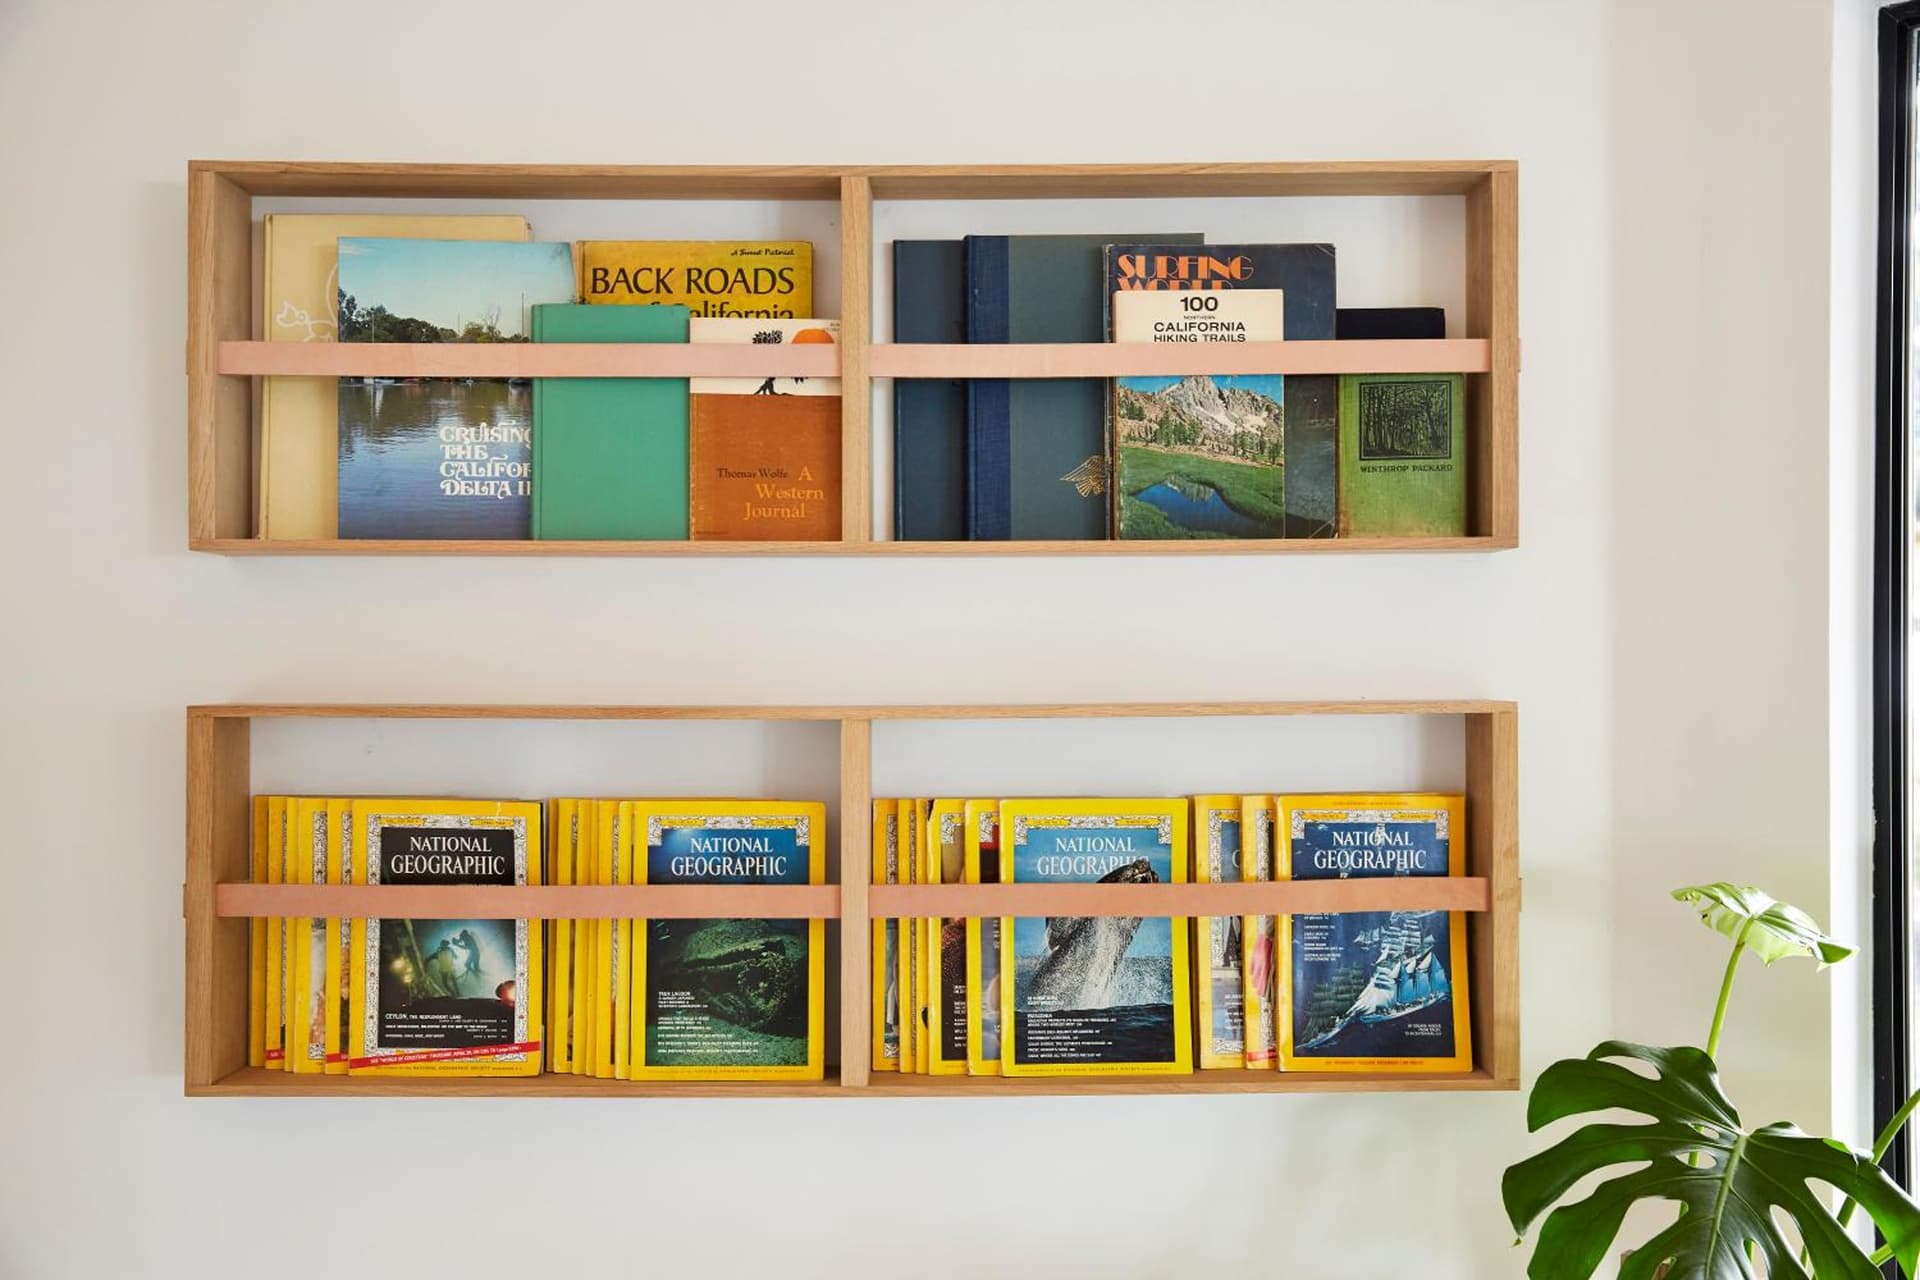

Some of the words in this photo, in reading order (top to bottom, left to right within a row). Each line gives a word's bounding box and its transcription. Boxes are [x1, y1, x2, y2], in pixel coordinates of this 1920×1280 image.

[1117, 254, 1254, 281] SURFING
[591, 267, 675, 295] BACK
[685, 267, 795, 295] ROADS
[1179, 296, 1219, 312] 100
[1153, 321, 1246, 333] CALIFORNIA
[1153, 333, 1198, 343] HIKING
[1202, 333, 1246, 343] TRAILS
[440, 444, 489, 460] THE
[716, 466, 757, 479] Thomas
[758, 466, 789, 479] Wolfe
[798, 465, 813, 481] A
[1360, 464, 1409, 473] WINTHROP
[1412, 463, 1453, 473] PACKARD
[440, 479, 513, 500] DELTA
[755, 483, 825, 500] Western
[743, 502, 807, 521] Journal
[409, 836, 492, 852] NATIONAL
[690, 837, 774, 853] NATIONAL
[1055, 836, 1137, 852] NATIONAL
[1332, 831, 1414, 846] NATIONAL
[391, 854, 505, 876] GEOGRAPHIC
[671, 855, 787, 877] GEOGRAPHIC
[1036, 855, 1150, 877] GEOGRAP
[1313, 849, 1427, 870] GEOGRAPHIC
